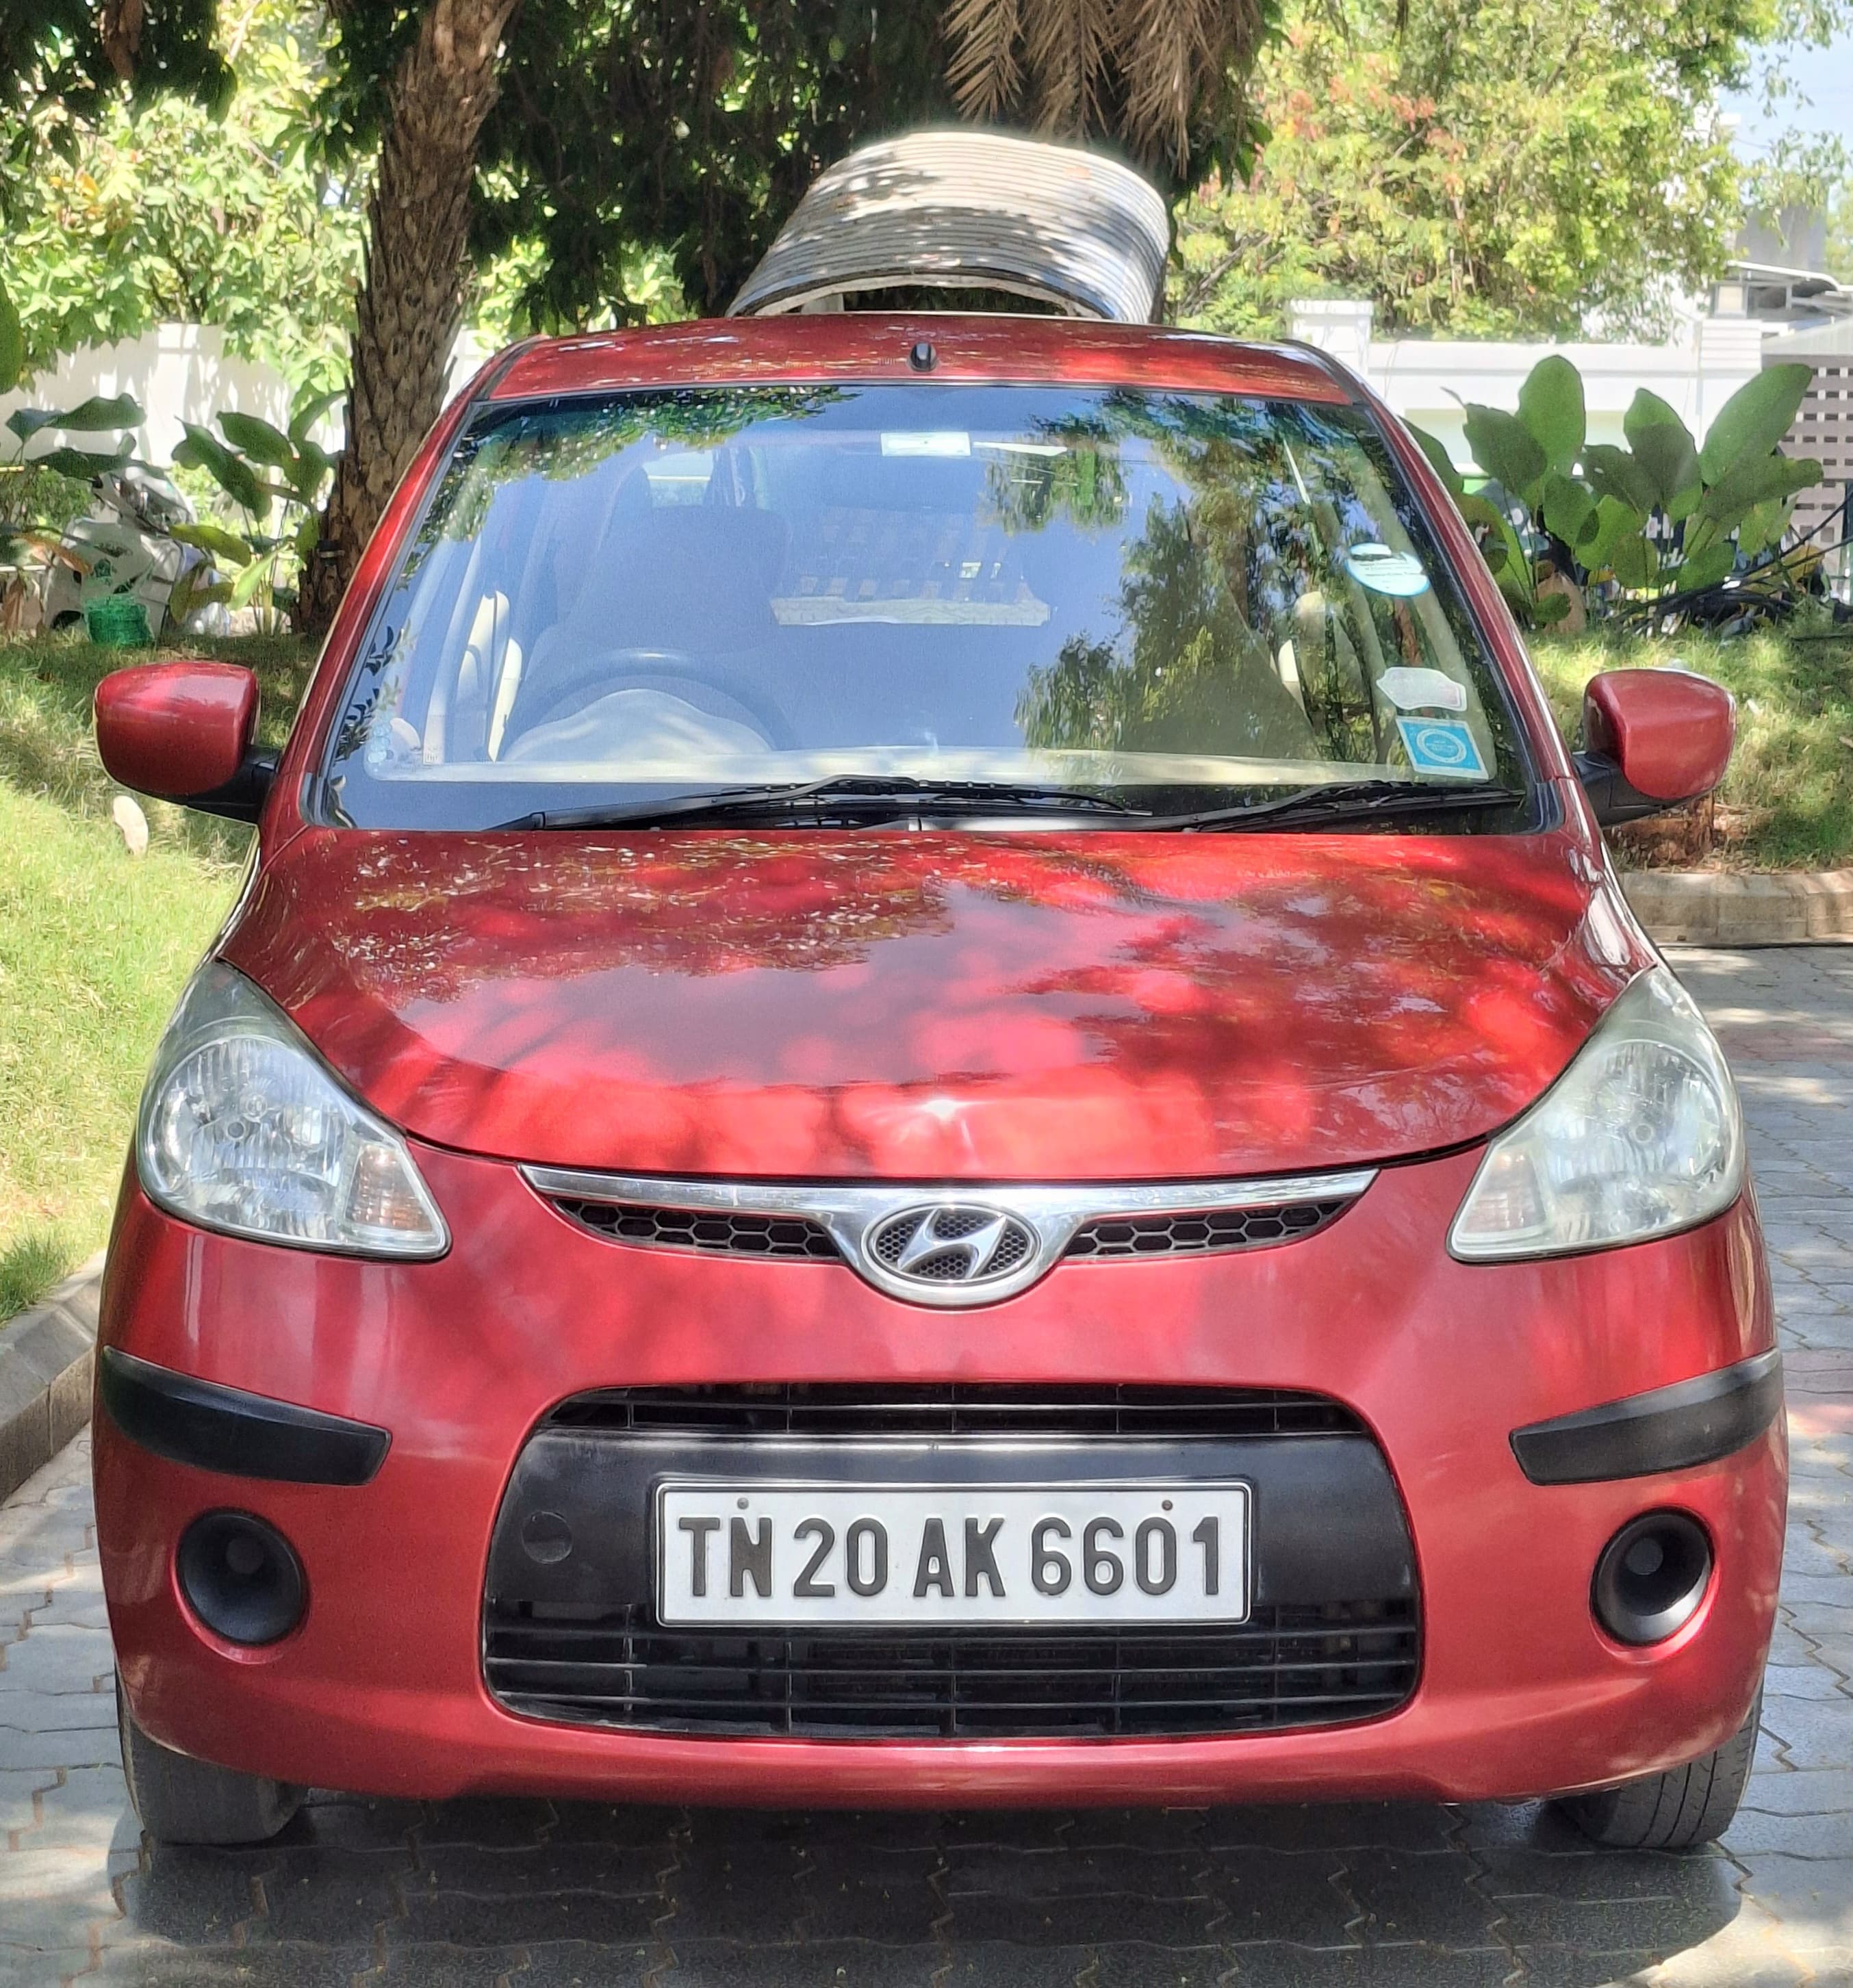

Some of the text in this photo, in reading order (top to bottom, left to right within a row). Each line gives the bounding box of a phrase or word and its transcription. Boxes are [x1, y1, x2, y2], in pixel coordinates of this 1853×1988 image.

[678, 1516, 1220, 1598] TN 20 AK 6601
